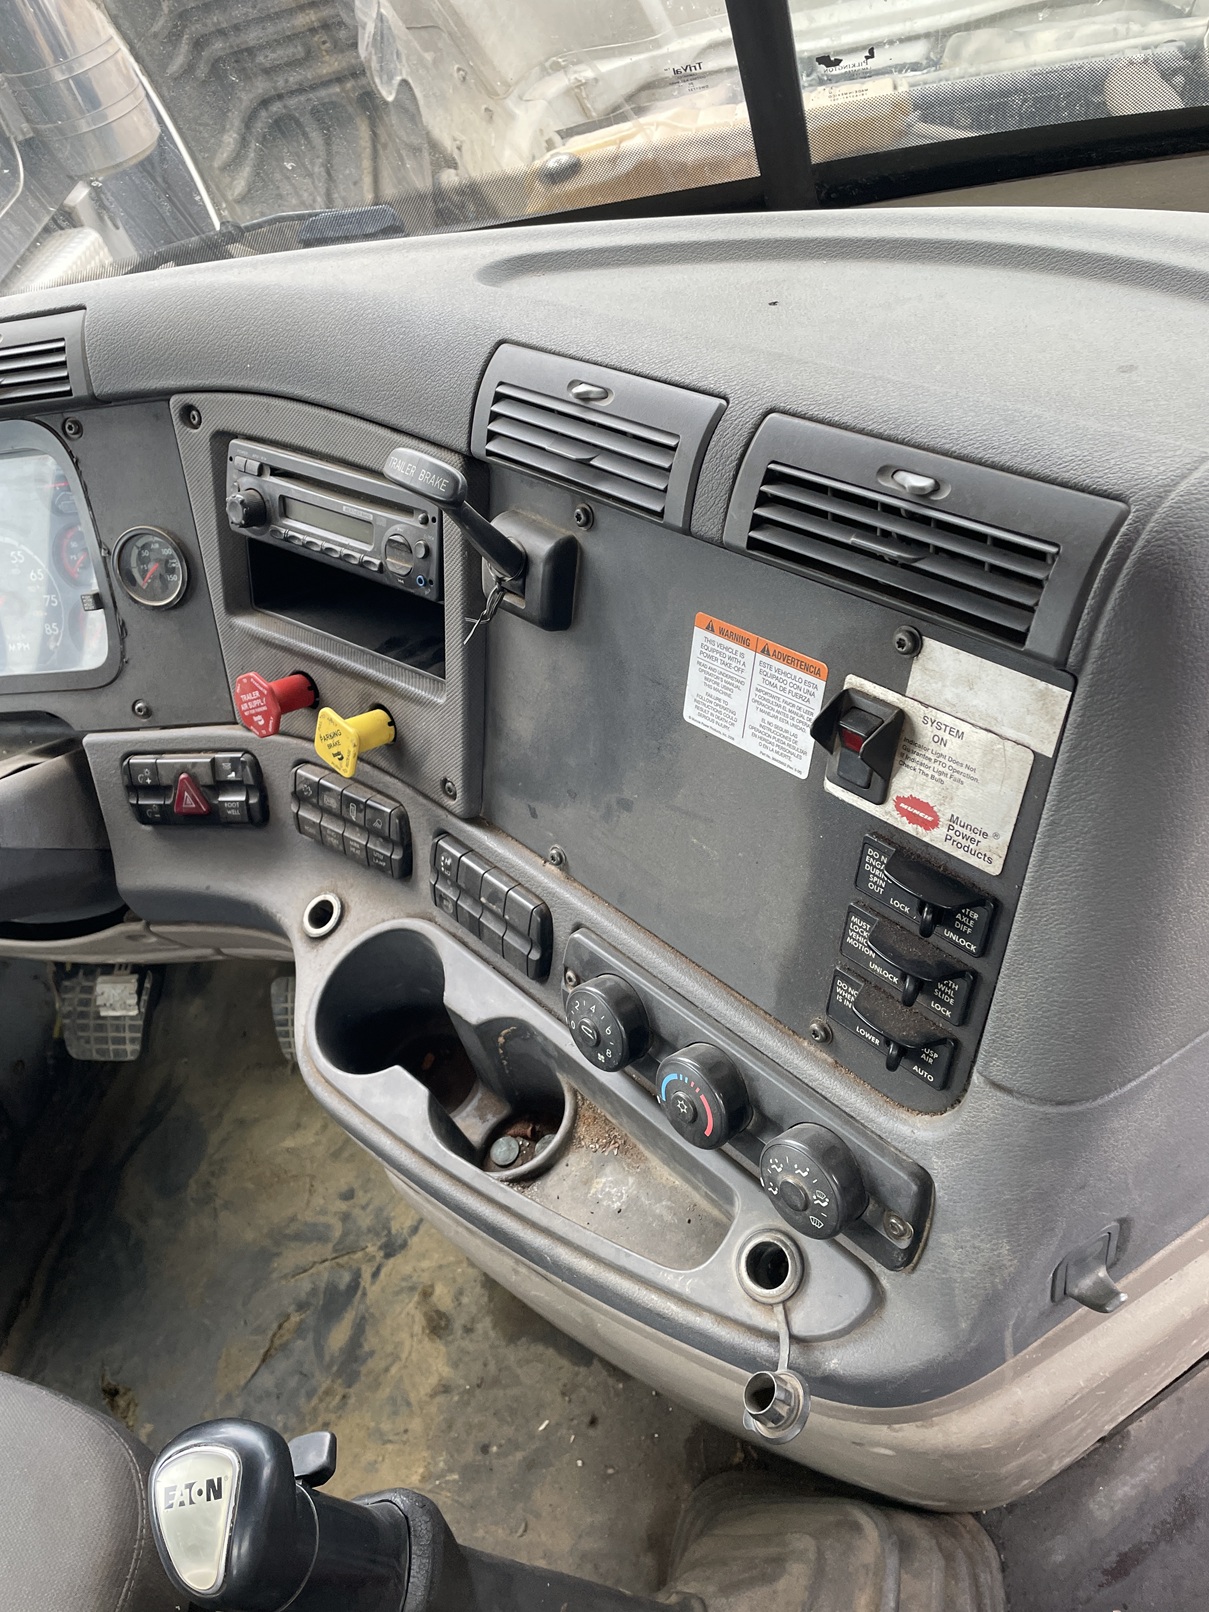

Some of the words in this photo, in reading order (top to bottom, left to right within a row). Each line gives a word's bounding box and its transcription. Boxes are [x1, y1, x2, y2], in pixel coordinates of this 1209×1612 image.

[388, 457, 416, 476] TRAILER
[418, 469, 449, 492] BRAKE
[10, 550, 24, 564] 55
[30, 568, 44, 581] 65
[43, 595, 58, 606] 75
[44, 622, 59, 635] 85
[718, 626, 750, 647] WARNING
[700, 642, 726, 658] EQUIPPED
[727, 654, 741, 665] WITH
[703, 636, 715, 646] THIS
[716, 641, 738, 656] VEHICLE
[739, 651, 744, 659] IS
[699, 650, 718, 663] POWER
[719, 658, 744, 674] TAKE-OFF
[771, 648, 821, 677] ADVERTENCIA
[696, 660, 707, 669] READ
[707, 665, 716, 673] AND
[717, 669, 745, 686] UNDERSTAND
[758, 659, 773, 671] ESTE
[773, 666, 803, 684] VEHICULO
[803, 679, 818, 690] ESTA
[703, 681, 712, 689] THIS
[759, 668, 787, 685] EQUIPADO
[788, 680, 801, 691] CON
[802, 687, 815, 697] UNA
[240, 690, 260, 702] TRAILER
[705, 691, 721, 702] FAILURE
[761, 677, 778, 689] TOMA
[778, 685, 787, 693] DE
[787, 689, 811, 704] FUERZA
[248, 697, 266, 709] SUPPLY
[696, 693, 712, 704] FOLLOW
[713, 701, 736, 715] OPERATING
[781, 698, 795, 708] FAVOR
[775, 708, 789, 719] ANTES
[795, 718, 811, 729] OPERA
[779, 716, 789, 725] ESTA
[788, 708, 805, 720] MANUAL
[922, 716, 964, 740] SYSTEM
[320, 729, 342, 743] PARKING
[932, 734, 948, 747] ON
[327, 740, 341, 749] BRAKE
[906, 754, 932, 770] Indicator
[932, 767, 948, 778] Light
[930, 749, 946, 760] Light
[948, 755, 964, 768] Does
[965, 763, 976, 773] Not
[933, 757, 947, 769] PTO
[899, 760, 917, 772] Check
[918, 767, 929, 777] The
[930, 772, 945, 785] Bulb
[900, 803, 935, 822] MUNCIE
[949, 813, 989, 839] Muncie
[947, 824, 981, 847] Power
[868, 848, 879, 858] DO
[945, 834, 993, 864] Products
[868, 882, 884, 895] OUT
[869, 874, 886, 888] SPIN
[890, 898, 910, 914] LOCK
[851, 916, 871, 930] MUST
[954, 921, 972, 934] DIFF
[956, 913, 975, 928] AXLE
[944, 928, 977, 952] UNLOCK
[846, 937, 876, 959] MOTION
[869, 962, 898, 984] UNLOCK
[836, 980, 847, 990] DO
[937, 982, 955, 998] WHL
[836, 994, 843, 1002] IS
[844, 999, 852, 1009] IN
[934, 988, 955, 1006] SLIDE
[574, 1000, 580, 1011] 2
[590, 1005, 596, 1013] 4
[931, 1001, 952, 1018] LOCK
[571, 1020, 576, 1030] 0
[605, 1025, 612, 1035] 6
[856, 1026, 880, 1046] LOWER
[606, 1048, 612, 1058] 8
[920, 1053, 934, 1065] AIR
[922, 1047, 939, 1059] USP
[912, 1065, 934, 1082] AUTO
[164, 1477, 222, 1510] EATON
